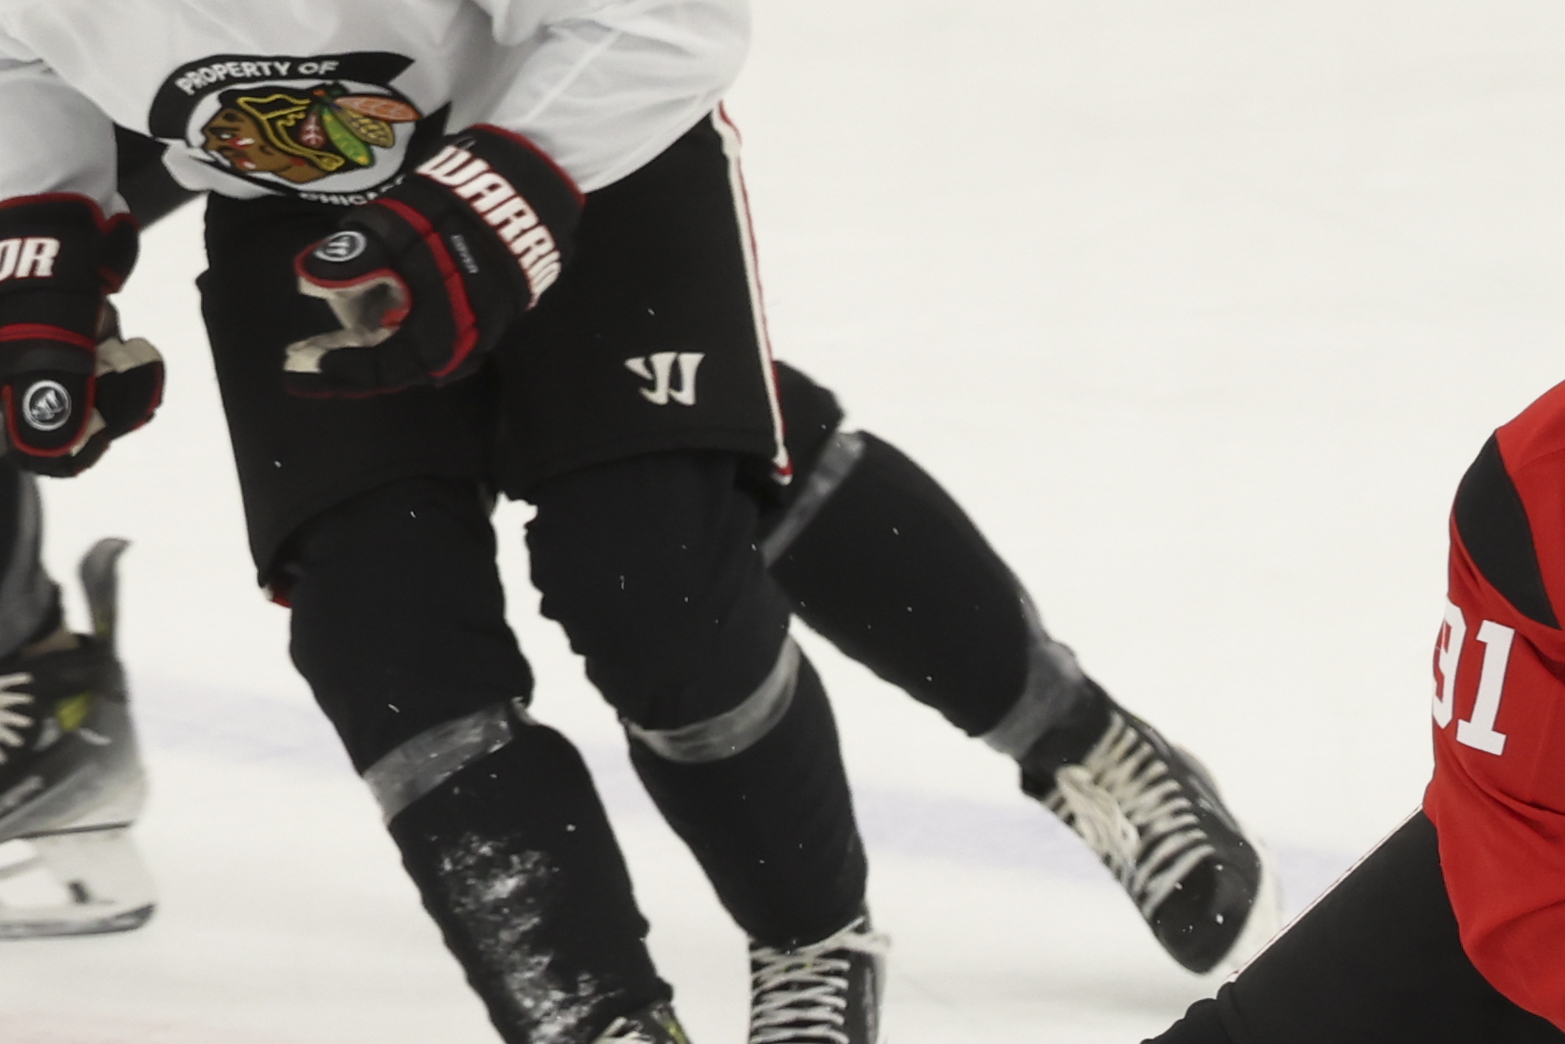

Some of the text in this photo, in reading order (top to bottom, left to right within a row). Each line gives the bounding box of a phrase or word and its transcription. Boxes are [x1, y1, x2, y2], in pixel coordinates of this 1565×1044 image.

[175, 60, 339, 95] PROPERTY OF
[1432, 600, 1516, 756] 91
